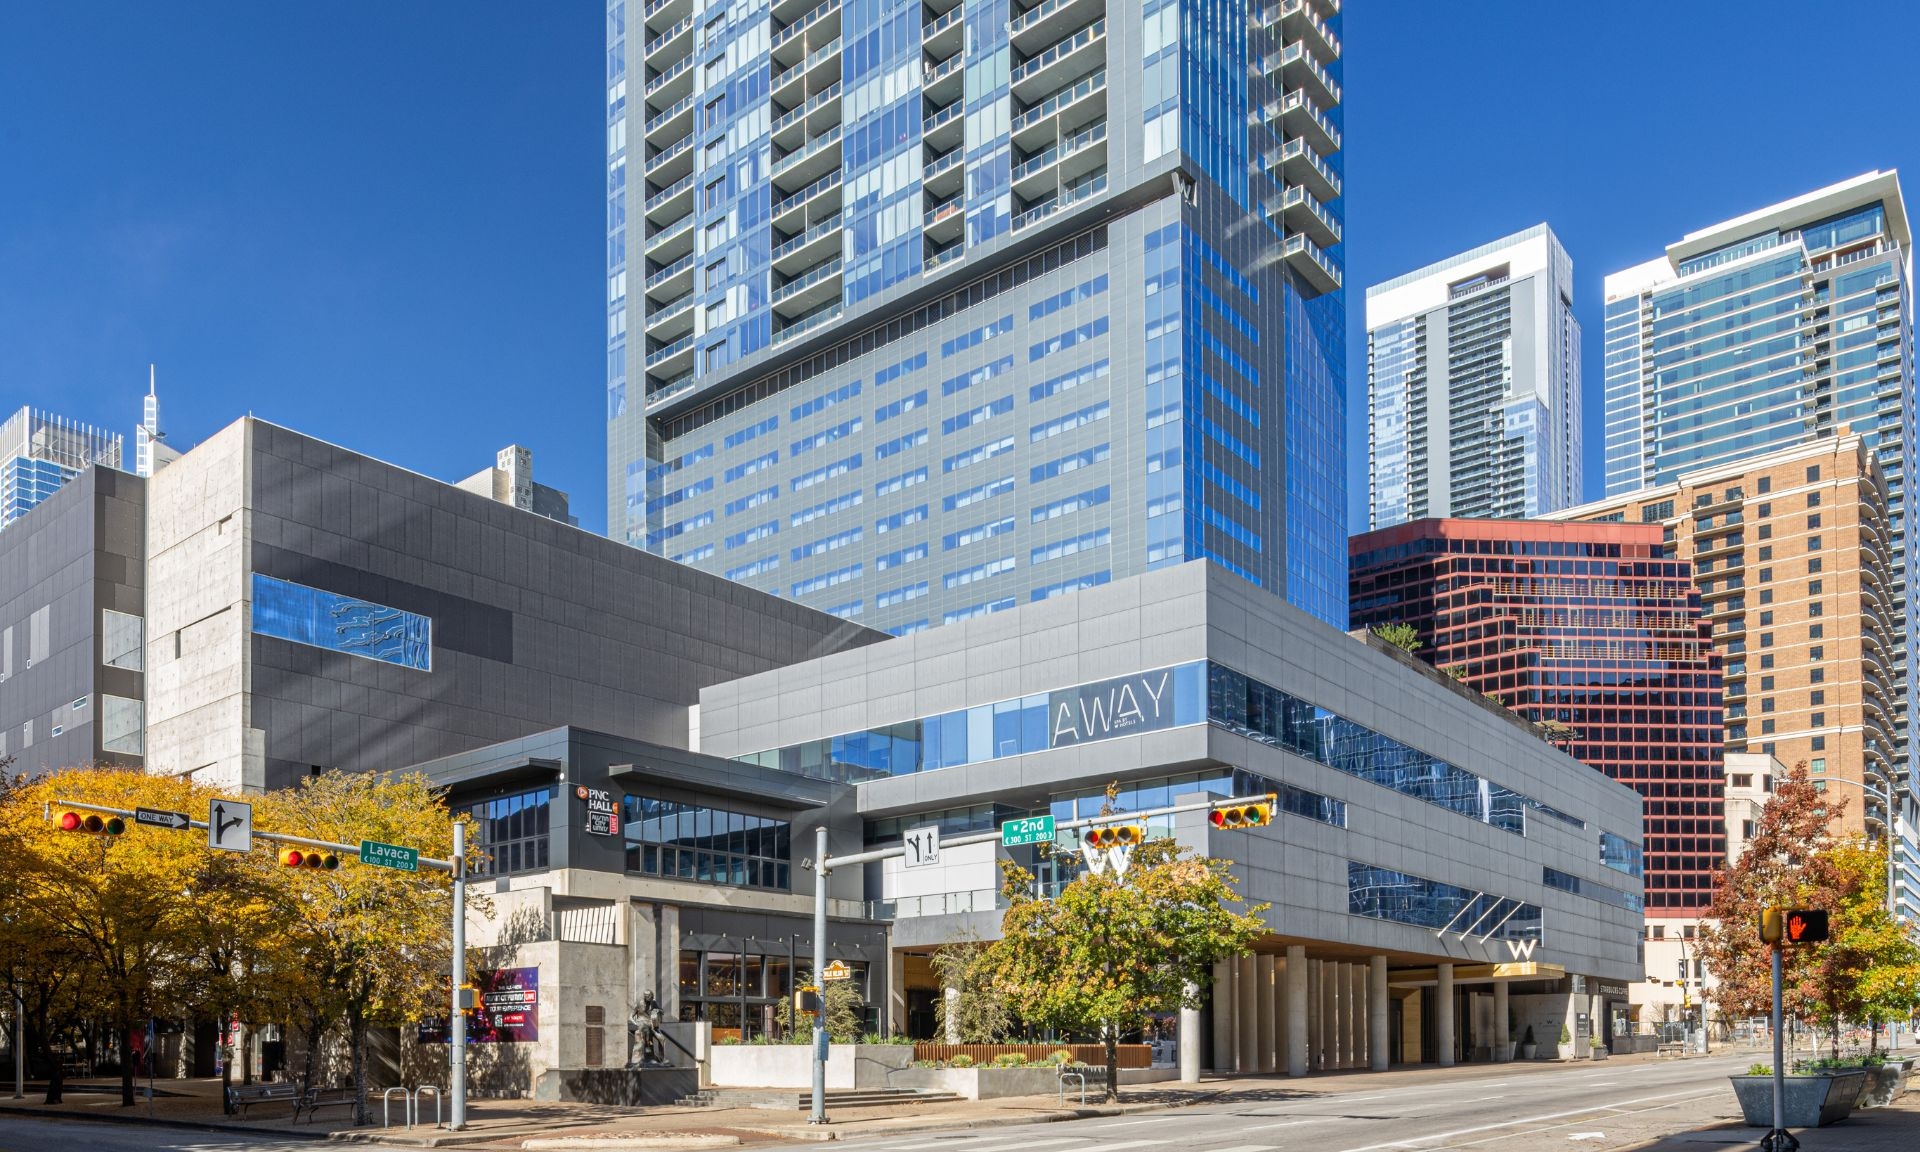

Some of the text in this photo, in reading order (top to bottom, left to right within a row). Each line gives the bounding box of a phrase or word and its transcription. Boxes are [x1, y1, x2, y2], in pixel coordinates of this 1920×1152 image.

[1053, 672, 1168, 746] AWAY
[1120, 720, 1136, 728] HOTELS
[588, 789, 608, 800] PNC
[589, 800, 612, 812] HALL
[140, 812, 174, 823] ONE WAY
[1020, 818, 1044, 832] 2nd
[1010, 836, 1021, 844] 300
[370, 843, 410, 860] Lavaca
[924, 854, 938, 862] ONLY
[1080, 841, 1136, 886] W
[1506, 939, 1538, 960] W
